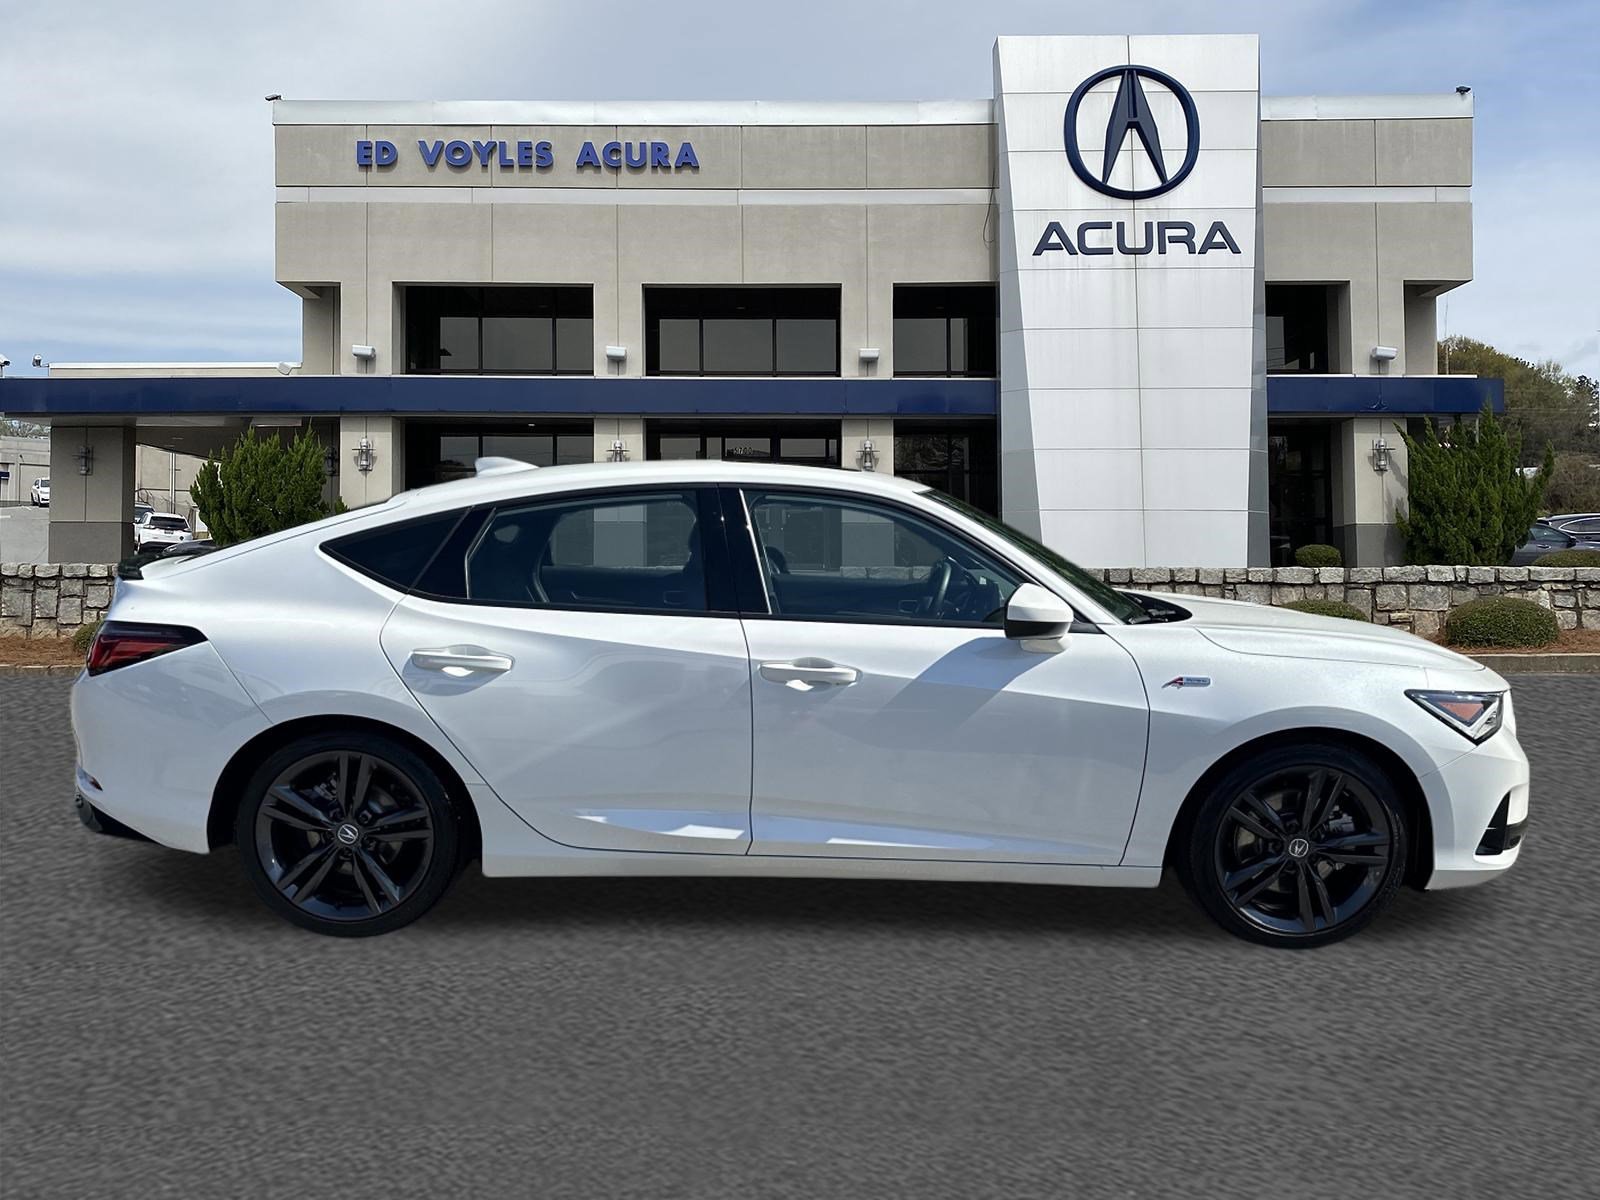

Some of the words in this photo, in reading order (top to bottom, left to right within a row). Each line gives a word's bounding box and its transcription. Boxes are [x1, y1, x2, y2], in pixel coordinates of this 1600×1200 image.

[356, 140, 398, 167] ED
[418, 140, 554, 168] VOYLES
[576, 141, 700, 168] ACURA
[1032, 221, 1242, 256] ACURA
